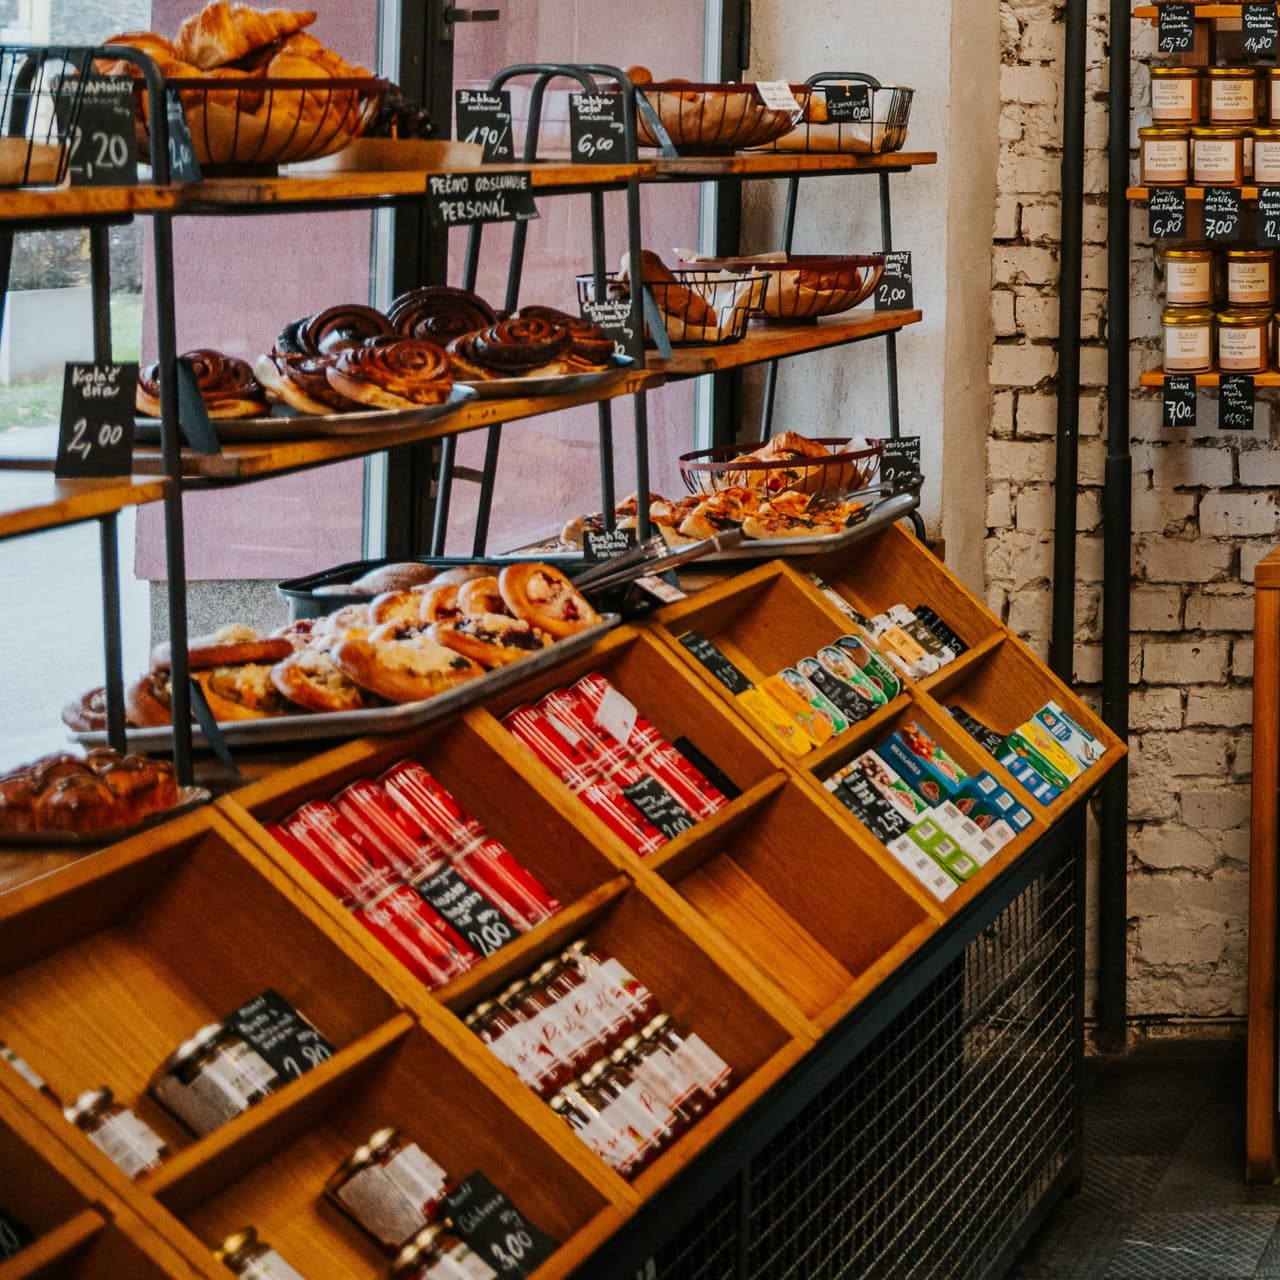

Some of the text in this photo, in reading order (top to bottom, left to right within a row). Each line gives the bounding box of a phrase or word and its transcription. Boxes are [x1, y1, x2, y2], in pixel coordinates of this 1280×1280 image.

[1160, 37, 1188, 53] 15,70
[1245, 37, 1272, 53] 14,80
[577, 134, 614, 157] 6,00
[430, 174, 468, 195] PEČIVO
[439, 192, 511, 221] PERSONÁL
[1153, 219, 1181, 237] 6,80
[1205, 218, 1232, 238] 7,00
[880, 284, 906, 306] 2,00
[72, 365, 121, 387] Koláč
[67, 418, 123, 459] 2,00
[889, 742, 922, 777] MEXILHÕES
